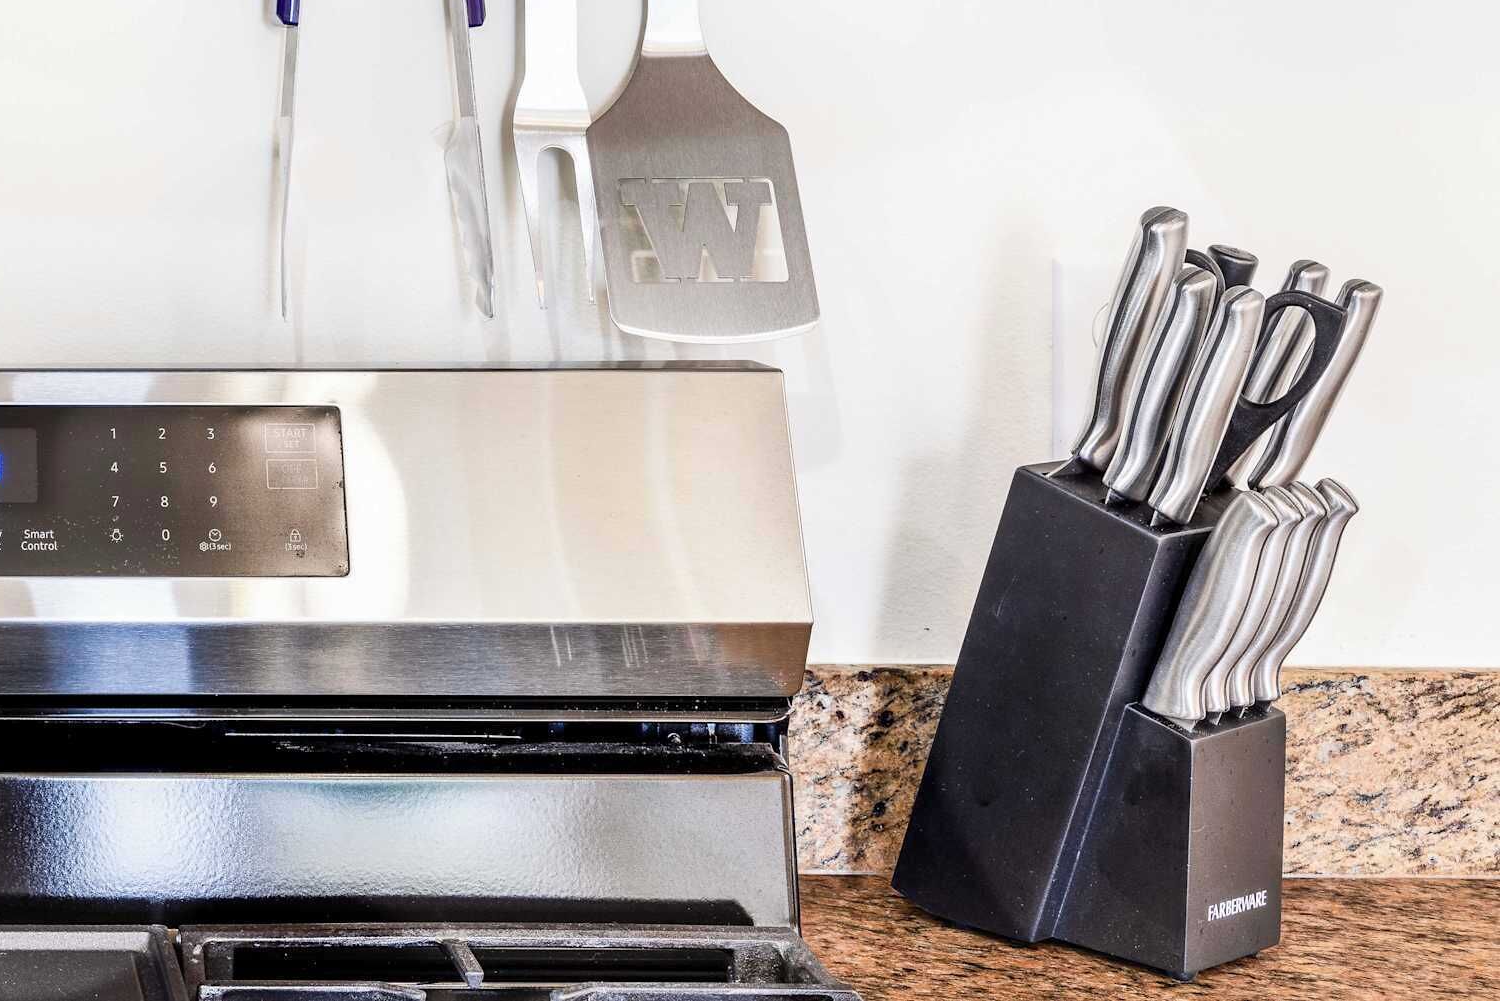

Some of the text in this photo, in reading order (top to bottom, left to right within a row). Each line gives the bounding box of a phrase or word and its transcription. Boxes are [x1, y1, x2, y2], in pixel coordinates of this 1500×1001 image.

[618, 180, 773, 279] W
[110, 427, 116, 439] 1
[158, 428, 166, 440] 2
[206, 427, 215, 440] 3
[110, 461, 119, 473] 4
[159, 462, 167, 473] 5
[208, 462, 216, 473] 6
[112, 495, 119, 507] 7
[160, 496, 169, 507] 8
[209, 496, 218, 507] 9
[24, 529, 54, 539] Smart
[161, 529, 170, 540] 0
[21, 541, 57, 550] Control
[1208, 890, 1267, 922] FARBERWARE
